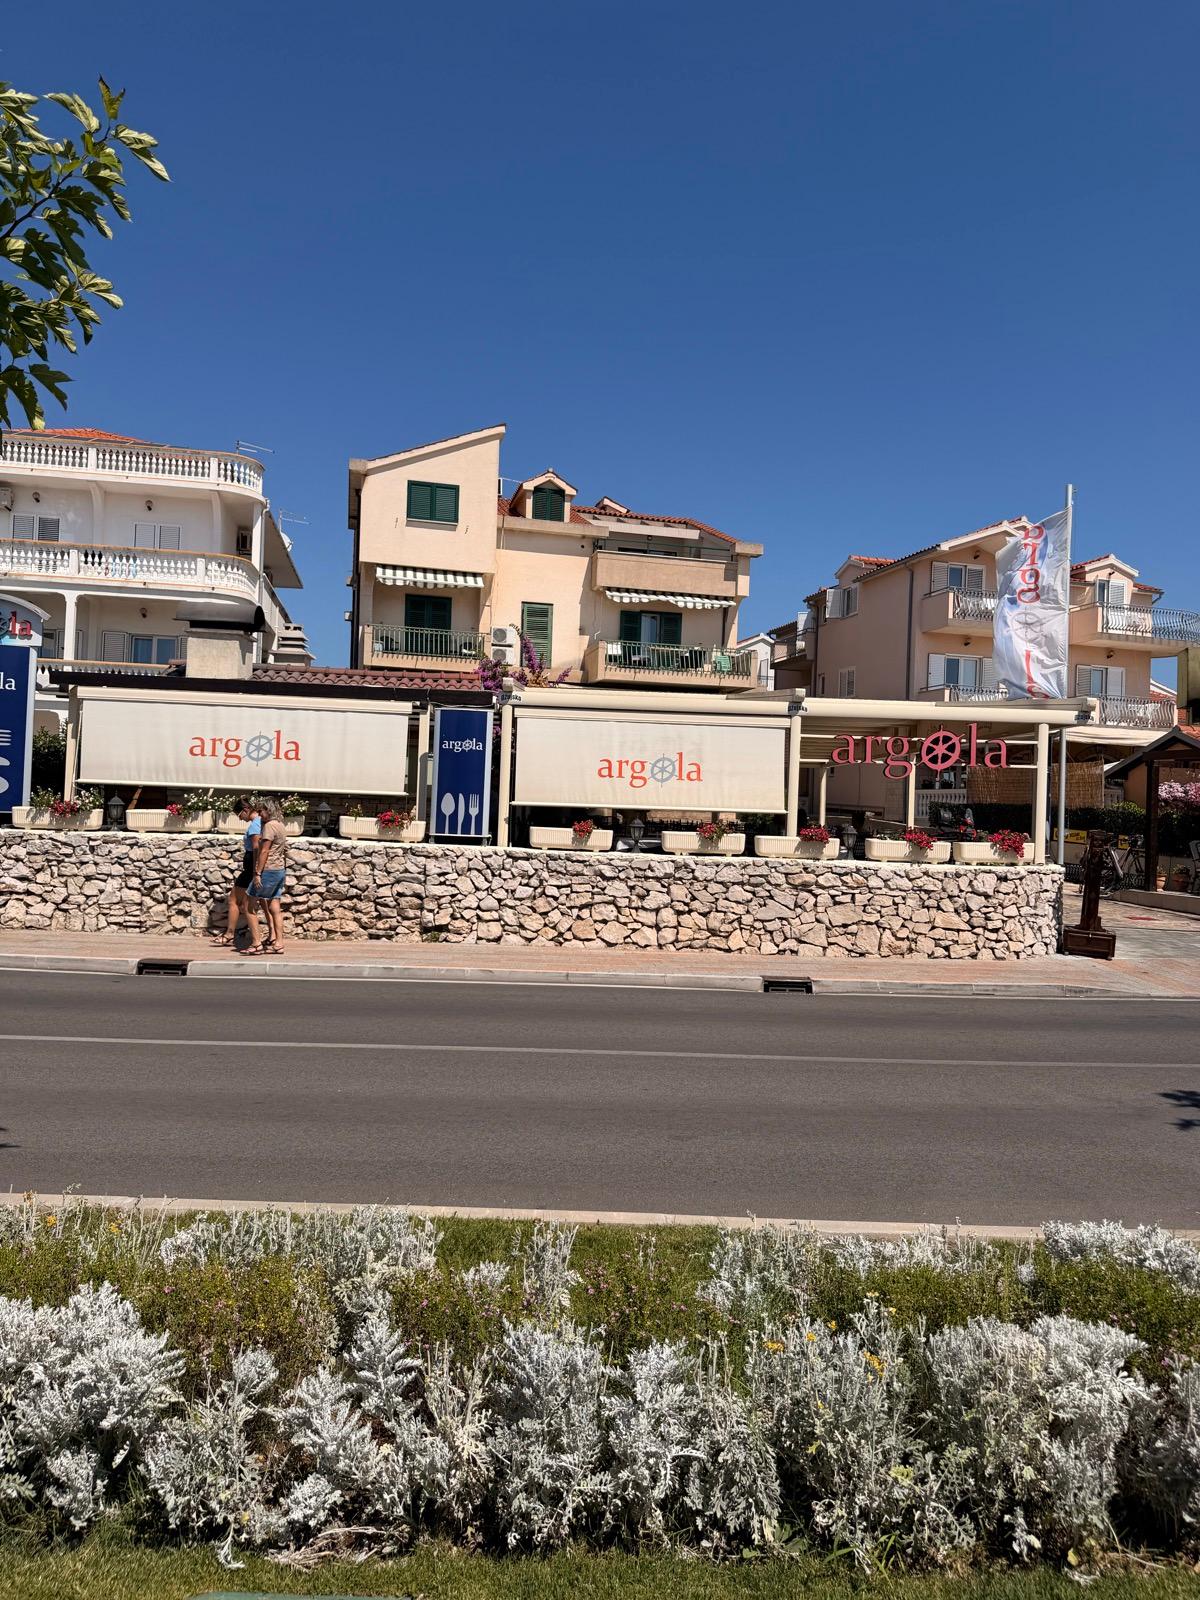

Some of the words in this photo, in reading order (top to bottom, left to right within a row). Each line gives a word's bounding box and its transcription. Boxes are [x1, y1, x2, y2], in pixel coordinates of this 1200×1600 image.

[189, 729, 301, 767] argola
[442, 738, 483, 753] argola
[831, 722, 1010, 780] argola
[597, 751, 703, 789] argola
